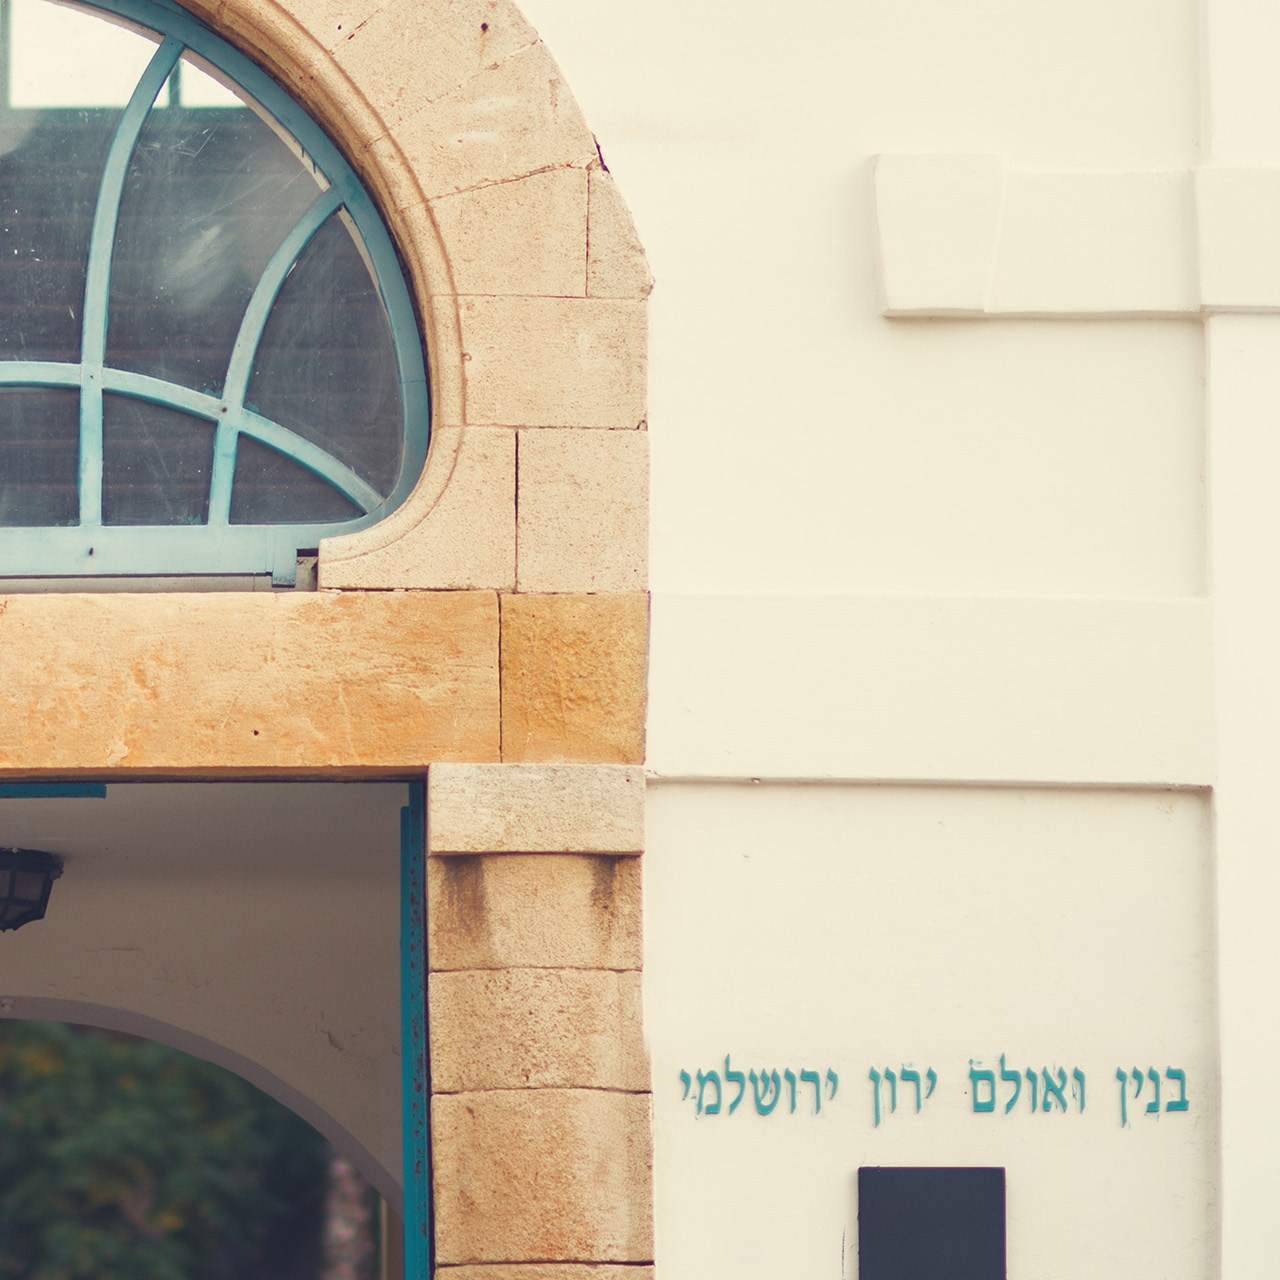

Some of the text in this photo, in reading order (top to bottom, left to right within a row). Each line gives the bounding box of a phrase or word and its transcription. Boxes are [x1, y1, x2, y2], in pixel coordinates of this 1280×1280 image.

[679, 1051, 1190, 1127] בנין ואולם ירון ירושלמי
